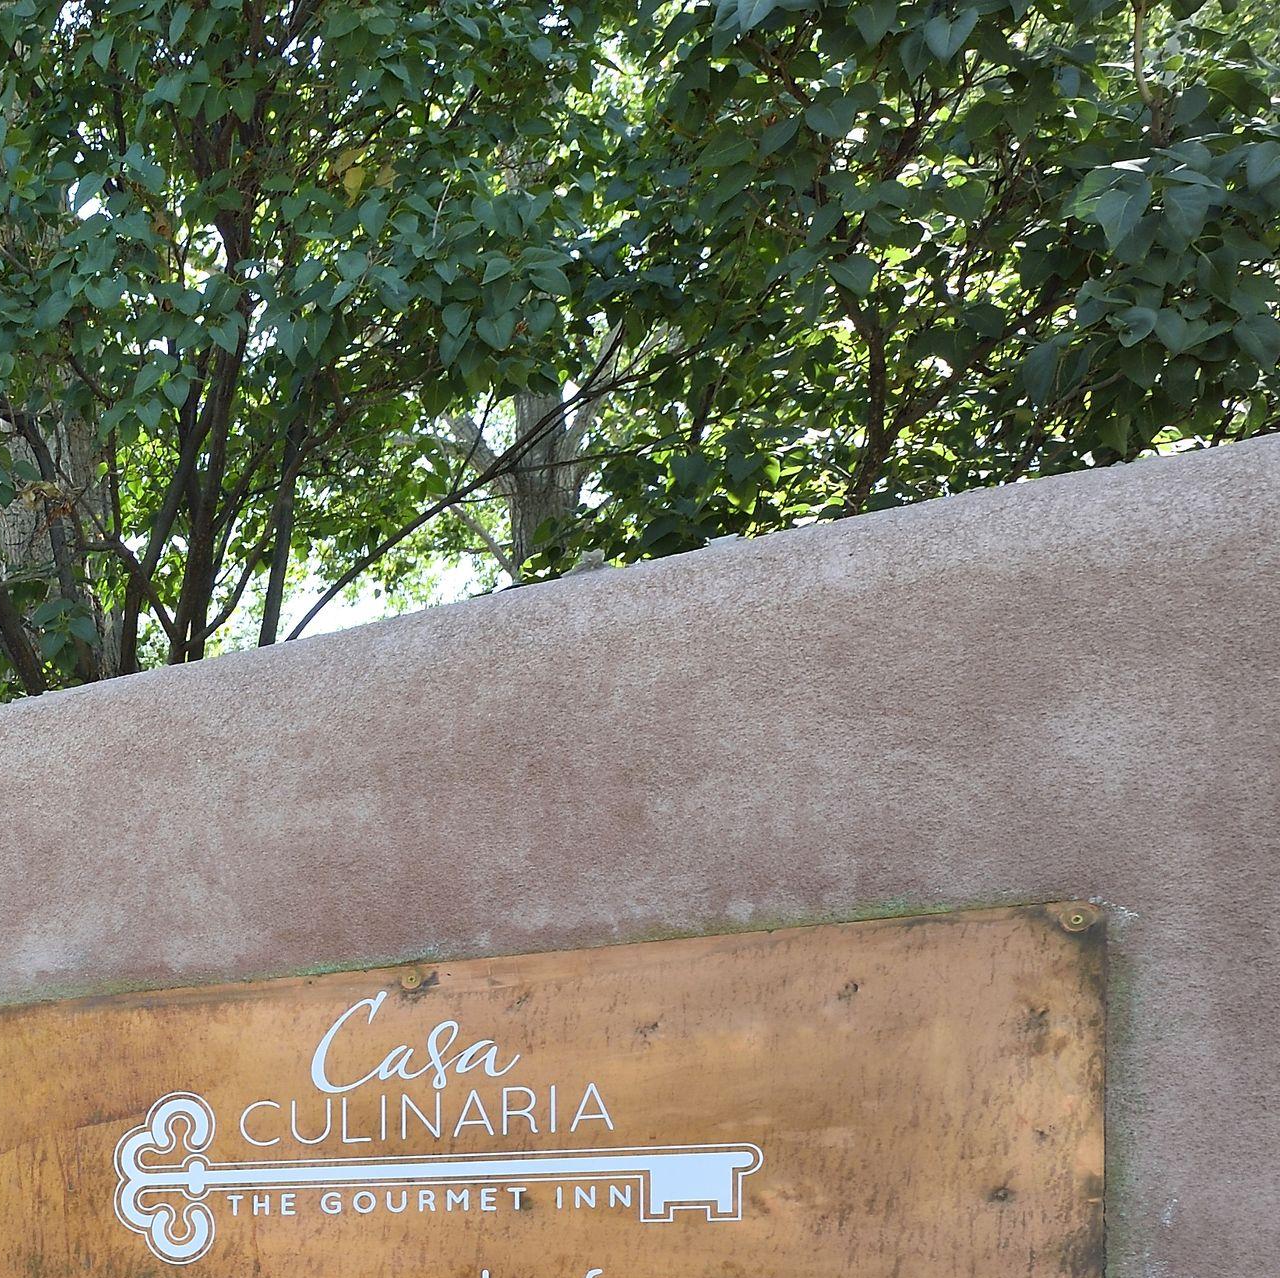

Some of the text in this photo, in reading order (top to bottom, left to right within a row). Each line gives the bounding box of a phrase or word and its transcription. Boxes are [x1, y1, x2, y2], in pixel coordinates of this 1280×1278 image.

[310, 990, 521, 1094] Casa
[239, 1082, 614, 1148] CULINARIA
[226, 1184, 632, 1217] THE GOURMET INN
